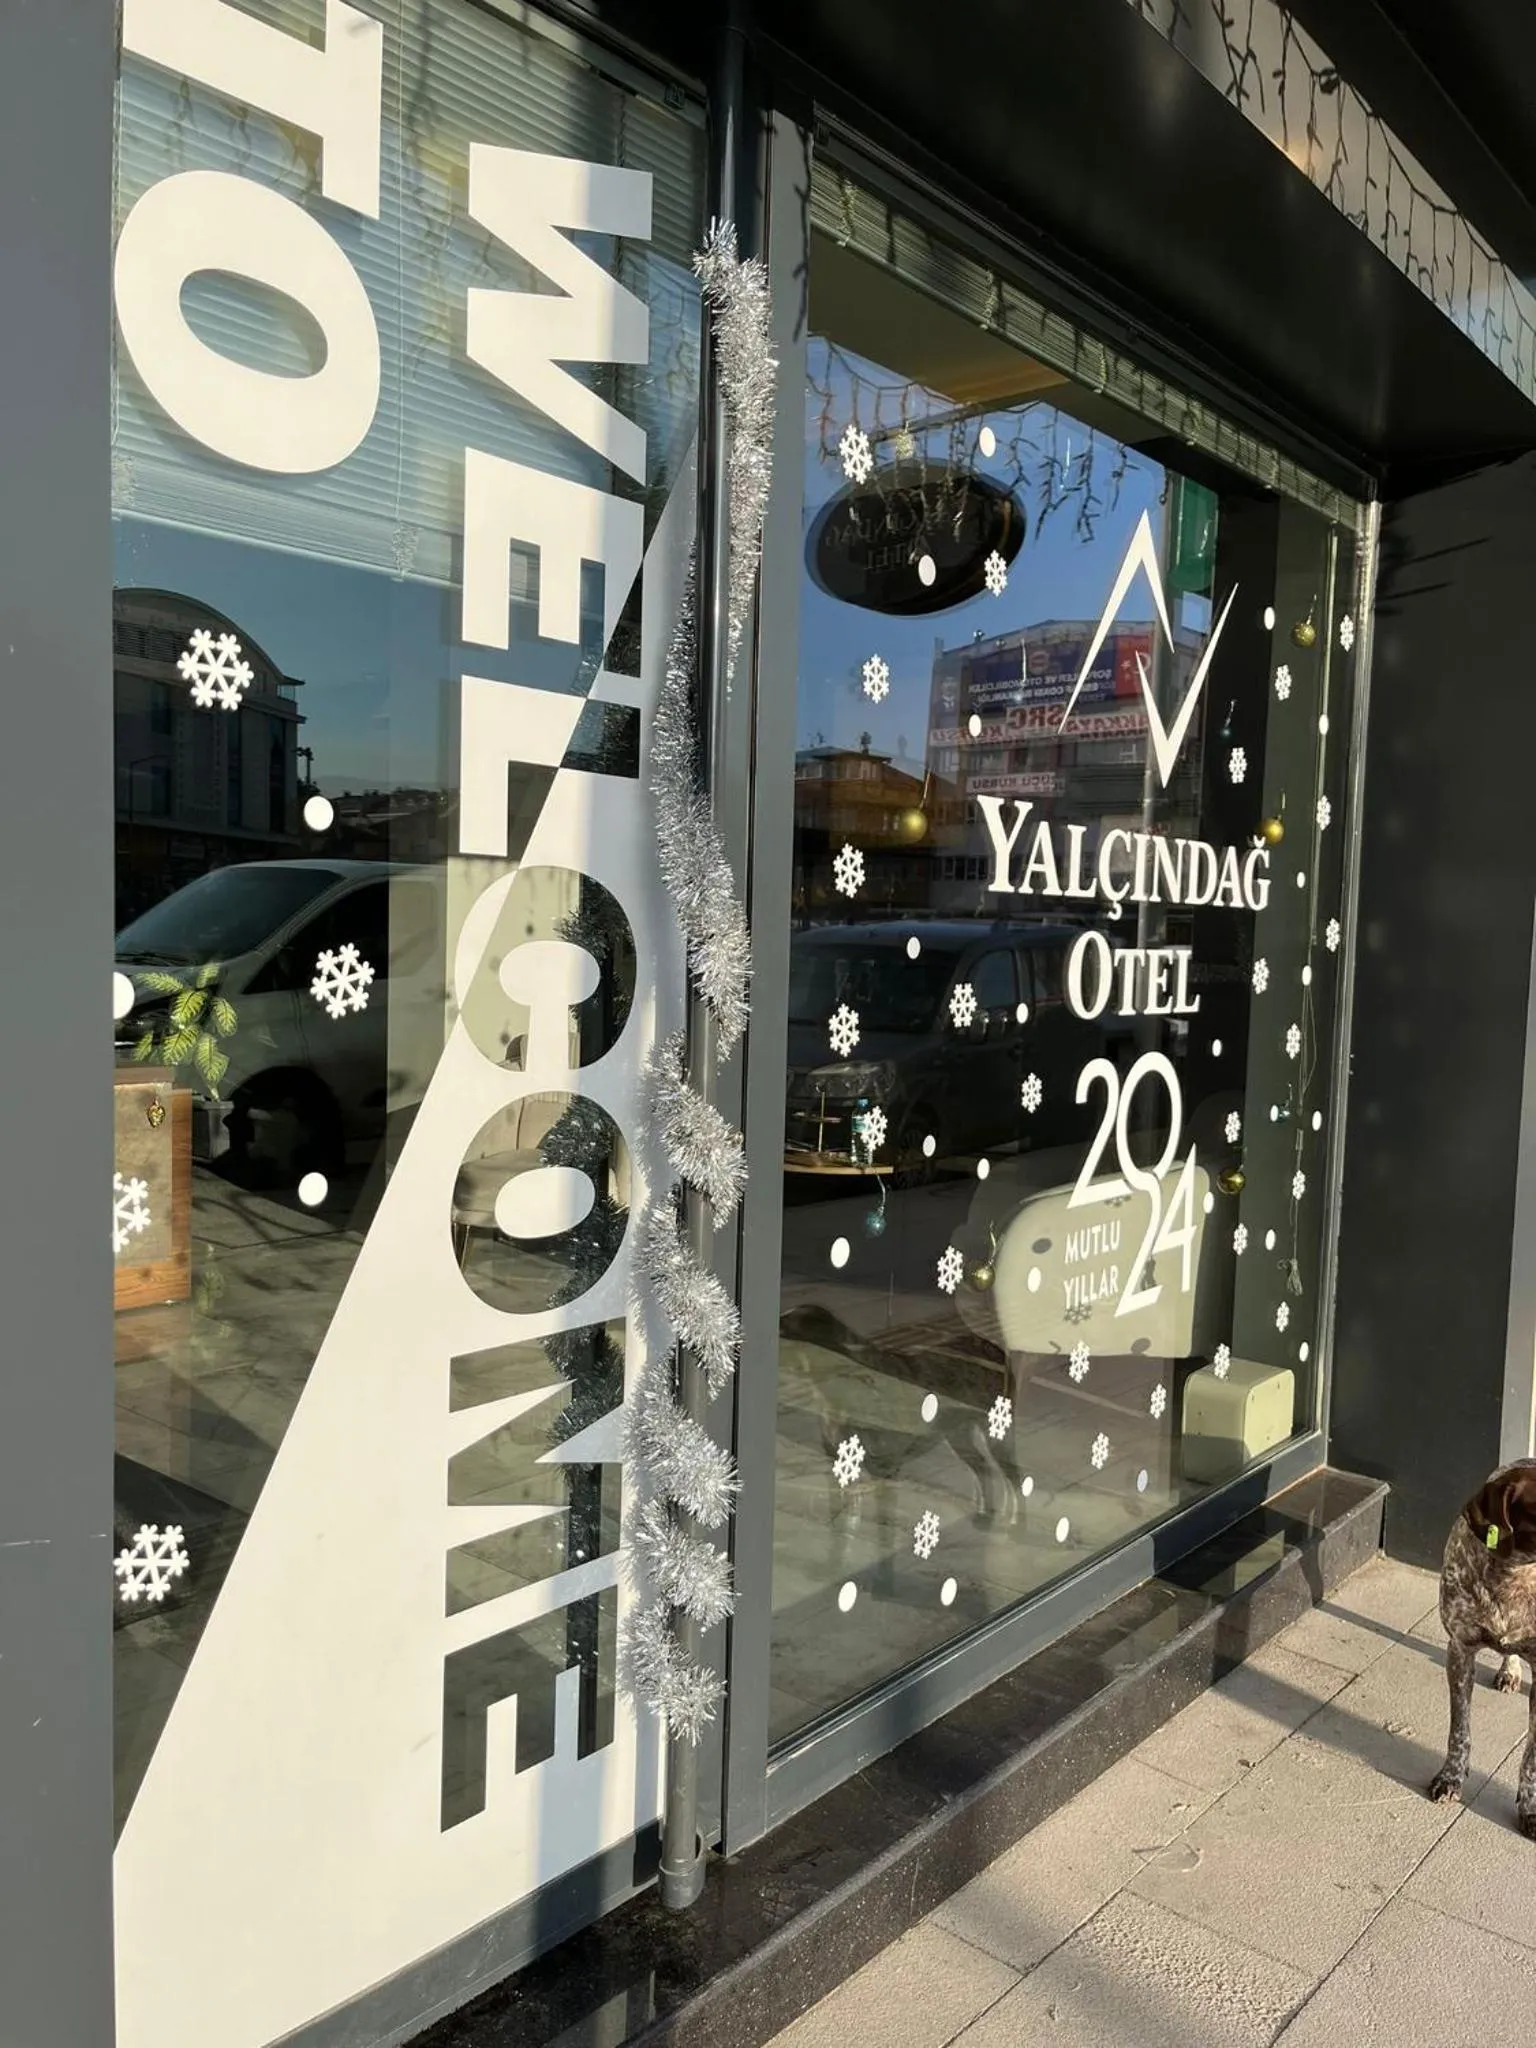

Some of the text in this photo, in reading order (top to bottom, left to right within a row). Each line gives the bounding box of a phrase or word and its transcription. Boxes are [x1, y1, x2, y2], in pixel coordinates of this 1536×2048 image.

[114, 0, 383, 474] TO
[976, 794, 1271, 921] YALÇINDAĞ
[440, 143, 654, 1834] WELCOME
[1067, 930, 1200, 1020] OTEL
[1064, 1219, 1121, 1265] MUTLU
[1064, 1264, 1119, 1311] YILLAR
